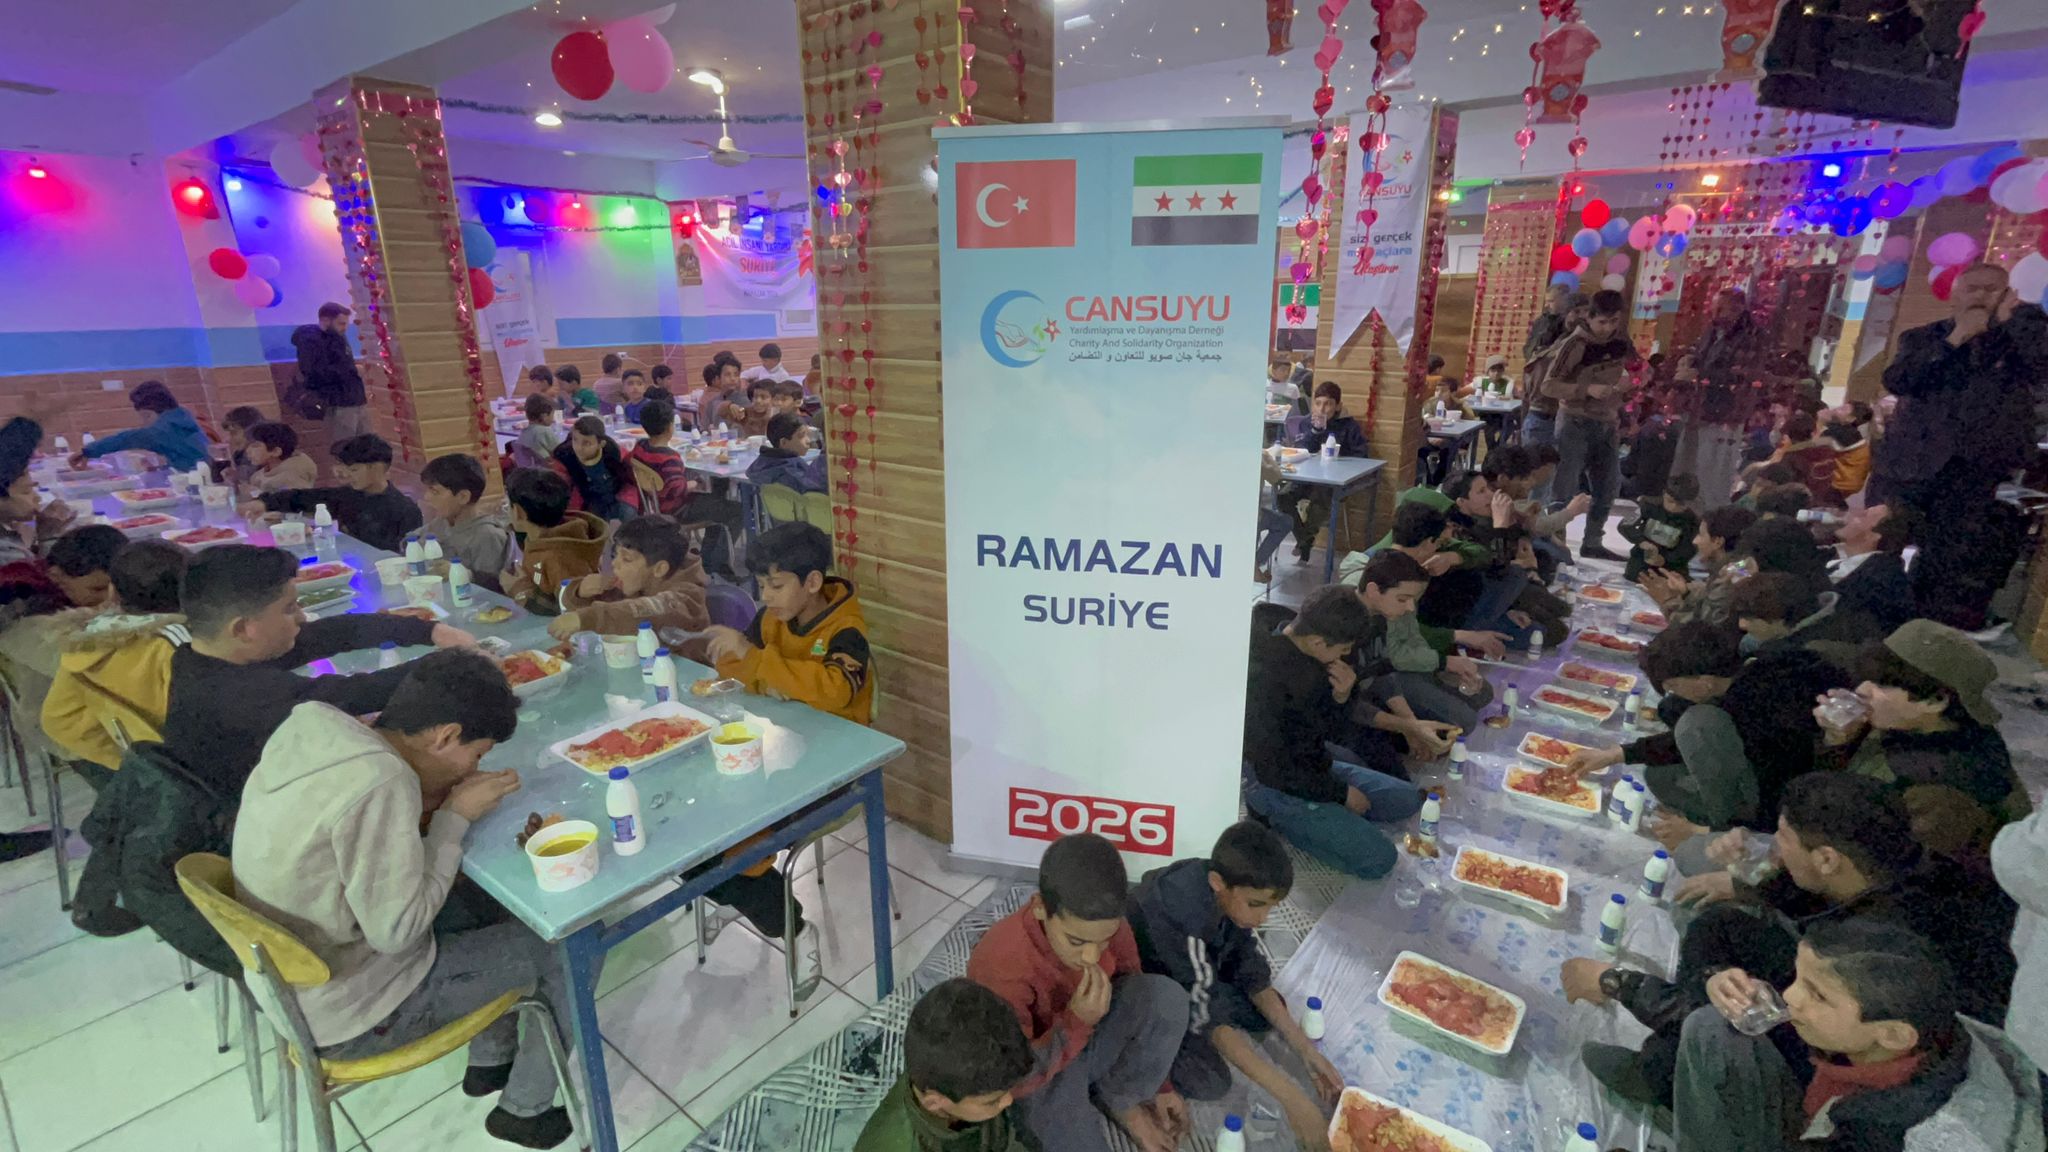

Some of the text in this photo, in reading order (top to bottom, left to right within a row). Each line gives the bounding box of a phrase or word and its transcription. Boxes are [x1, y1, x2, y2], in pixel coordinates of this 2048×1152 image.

[1360, 184, 1412, 197] ANSUYU
[1065, 295, 1231, 322] CANSUYU
[1069, 326, 1124, 336] Yardımlaşma
[1138, 326, 1186, 336] Dayanışma
[1188, 325, 1225, 336] Derneği
[1069, 338, 1224, 349] Charity And Solidarity Organization
[1114, 351, 1145, 363] للتعاون
[1175, 352, 1193, 363] جان
[1196, 351, 1222, 362] جمعية
[976, 534, 1223, 579] RAMAZAN
[1023, 592, 1170, 630] SURİYE
[1015, 792, 1168, 846] 2026
